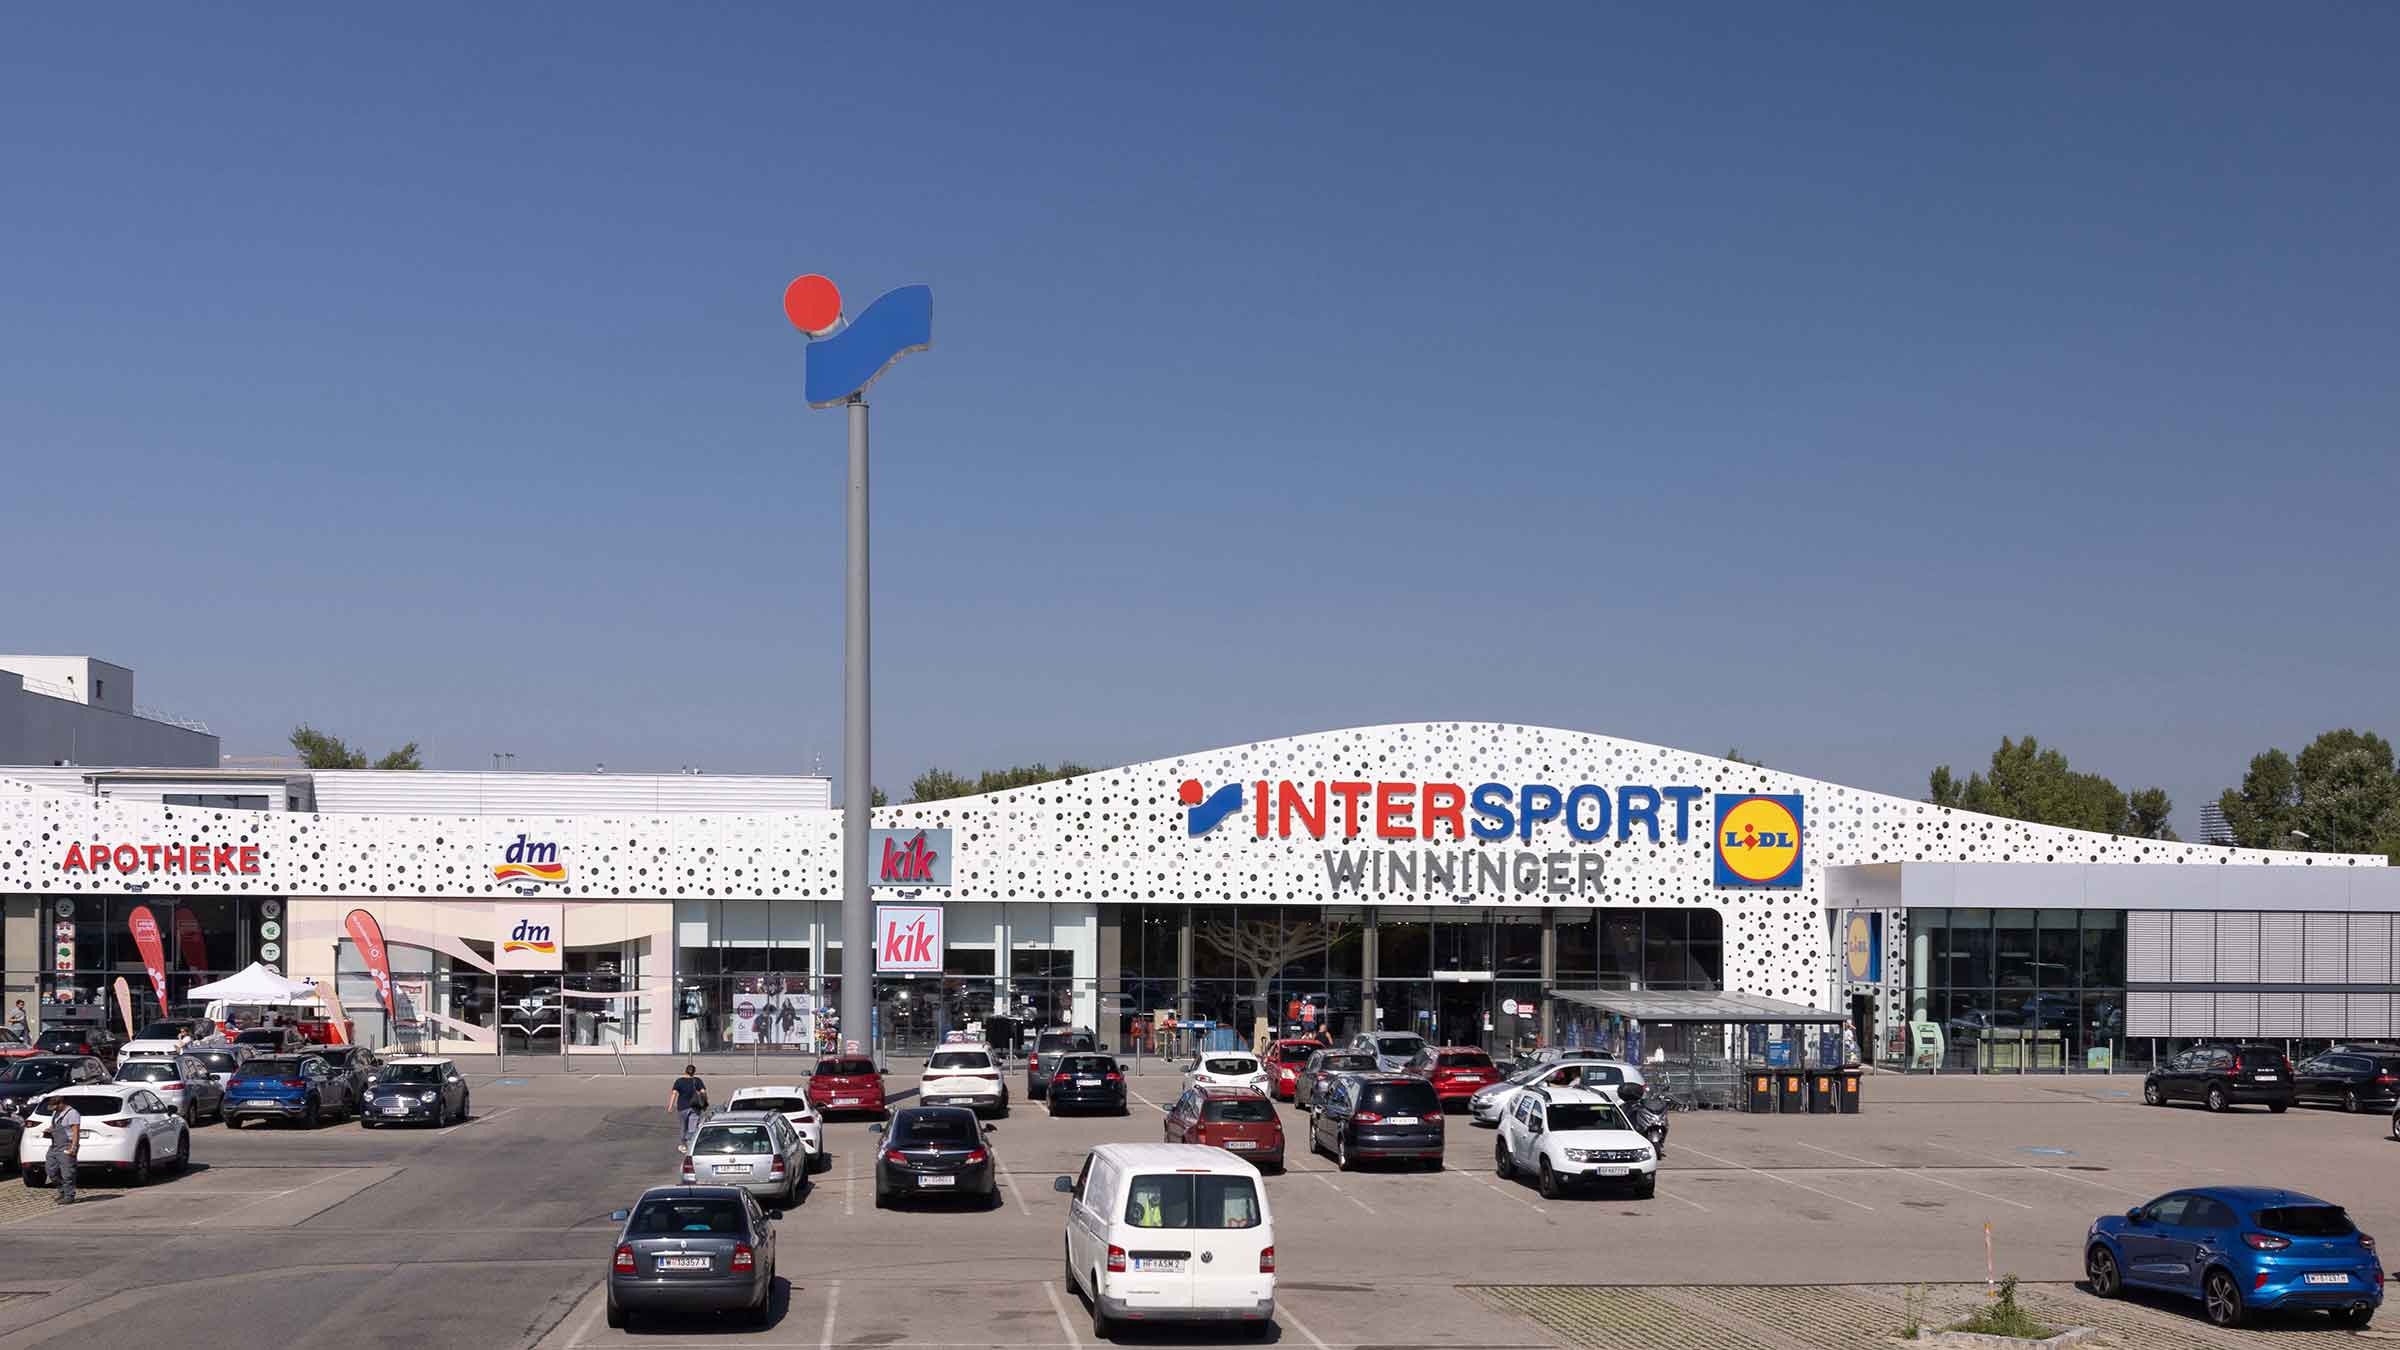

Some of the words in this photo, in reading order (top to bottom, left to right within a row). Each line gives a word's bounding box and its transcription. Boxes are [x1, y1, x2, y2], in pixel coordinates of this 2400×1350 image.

[1256, 780, 1703, 843] INTERSPORT
[63, 843, 261, 874] APOTHEKE
[505, 834, 557, 863] dm
[1323, 850, 1606, 895] WINNINGER
[512, 920, 551, 941] dm
